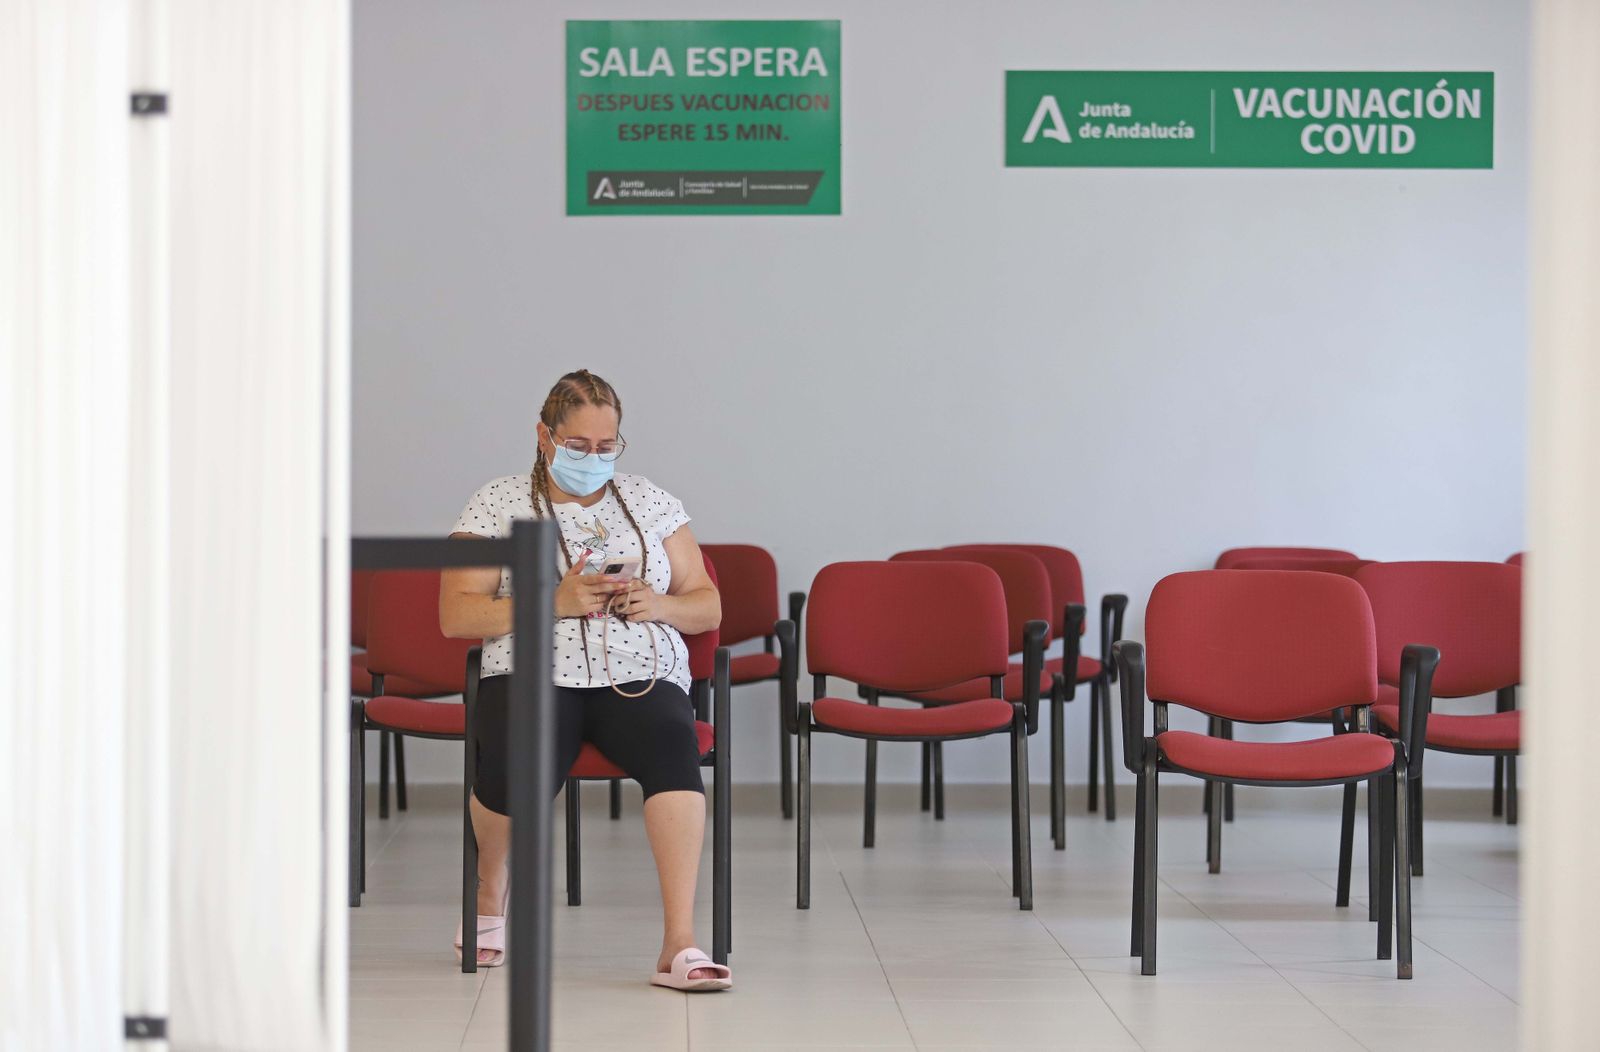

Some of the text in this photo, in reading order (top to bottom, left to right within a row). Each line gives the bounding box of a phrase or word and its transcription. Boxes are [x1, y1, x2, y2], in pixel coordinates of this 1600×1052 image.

[578, 46, 829, 78] SALA ESPERA
[577, 93, 830, 113] DESPUES VACUNACION
[1233, 78, 1481, 119] VACUNACIÓN
[1079, 101, 1132, 118] Junta
[618, 123, 789, 142] ESPERE 15 MIN.
[1079, 120, 1195, 140] de Andalucía
[1300, 124, 1417, 155] COVID
[618, 180, 645, 188] Junta
